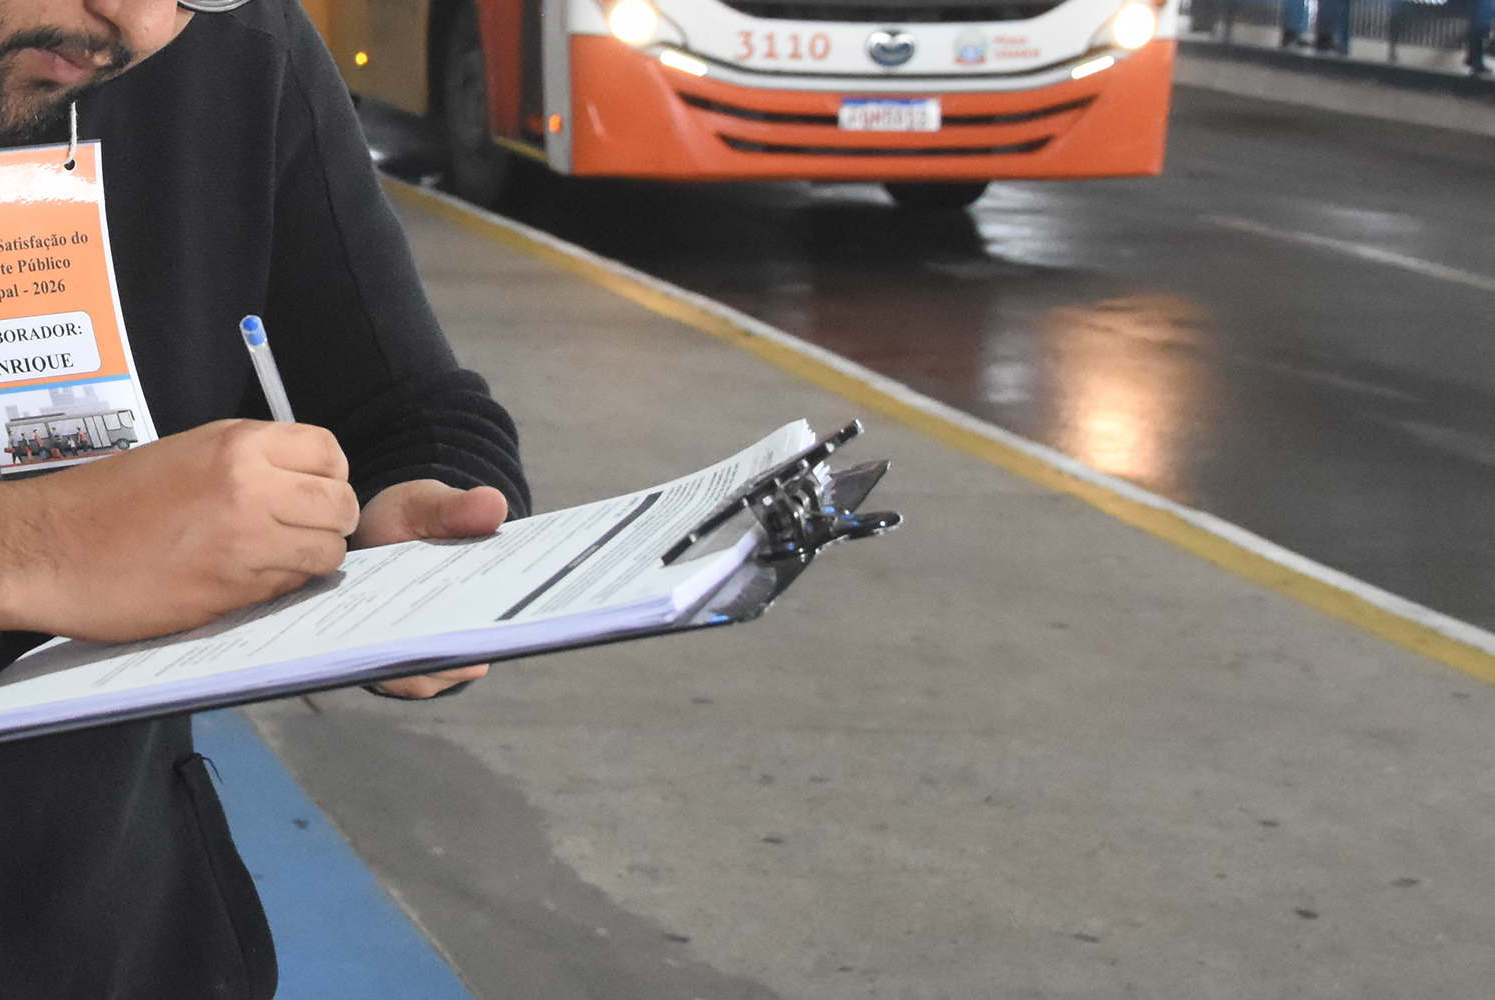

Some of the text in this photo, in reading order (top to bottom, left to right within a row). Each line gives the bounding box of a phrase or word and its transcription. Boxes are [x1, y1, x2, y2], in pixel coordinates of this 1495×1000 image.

[734, 30, 832, 61] 3110
[71, 231, 88, 245] do
[17, 257, 71, 273] Público
[32, 279, 66, 295] 2026
